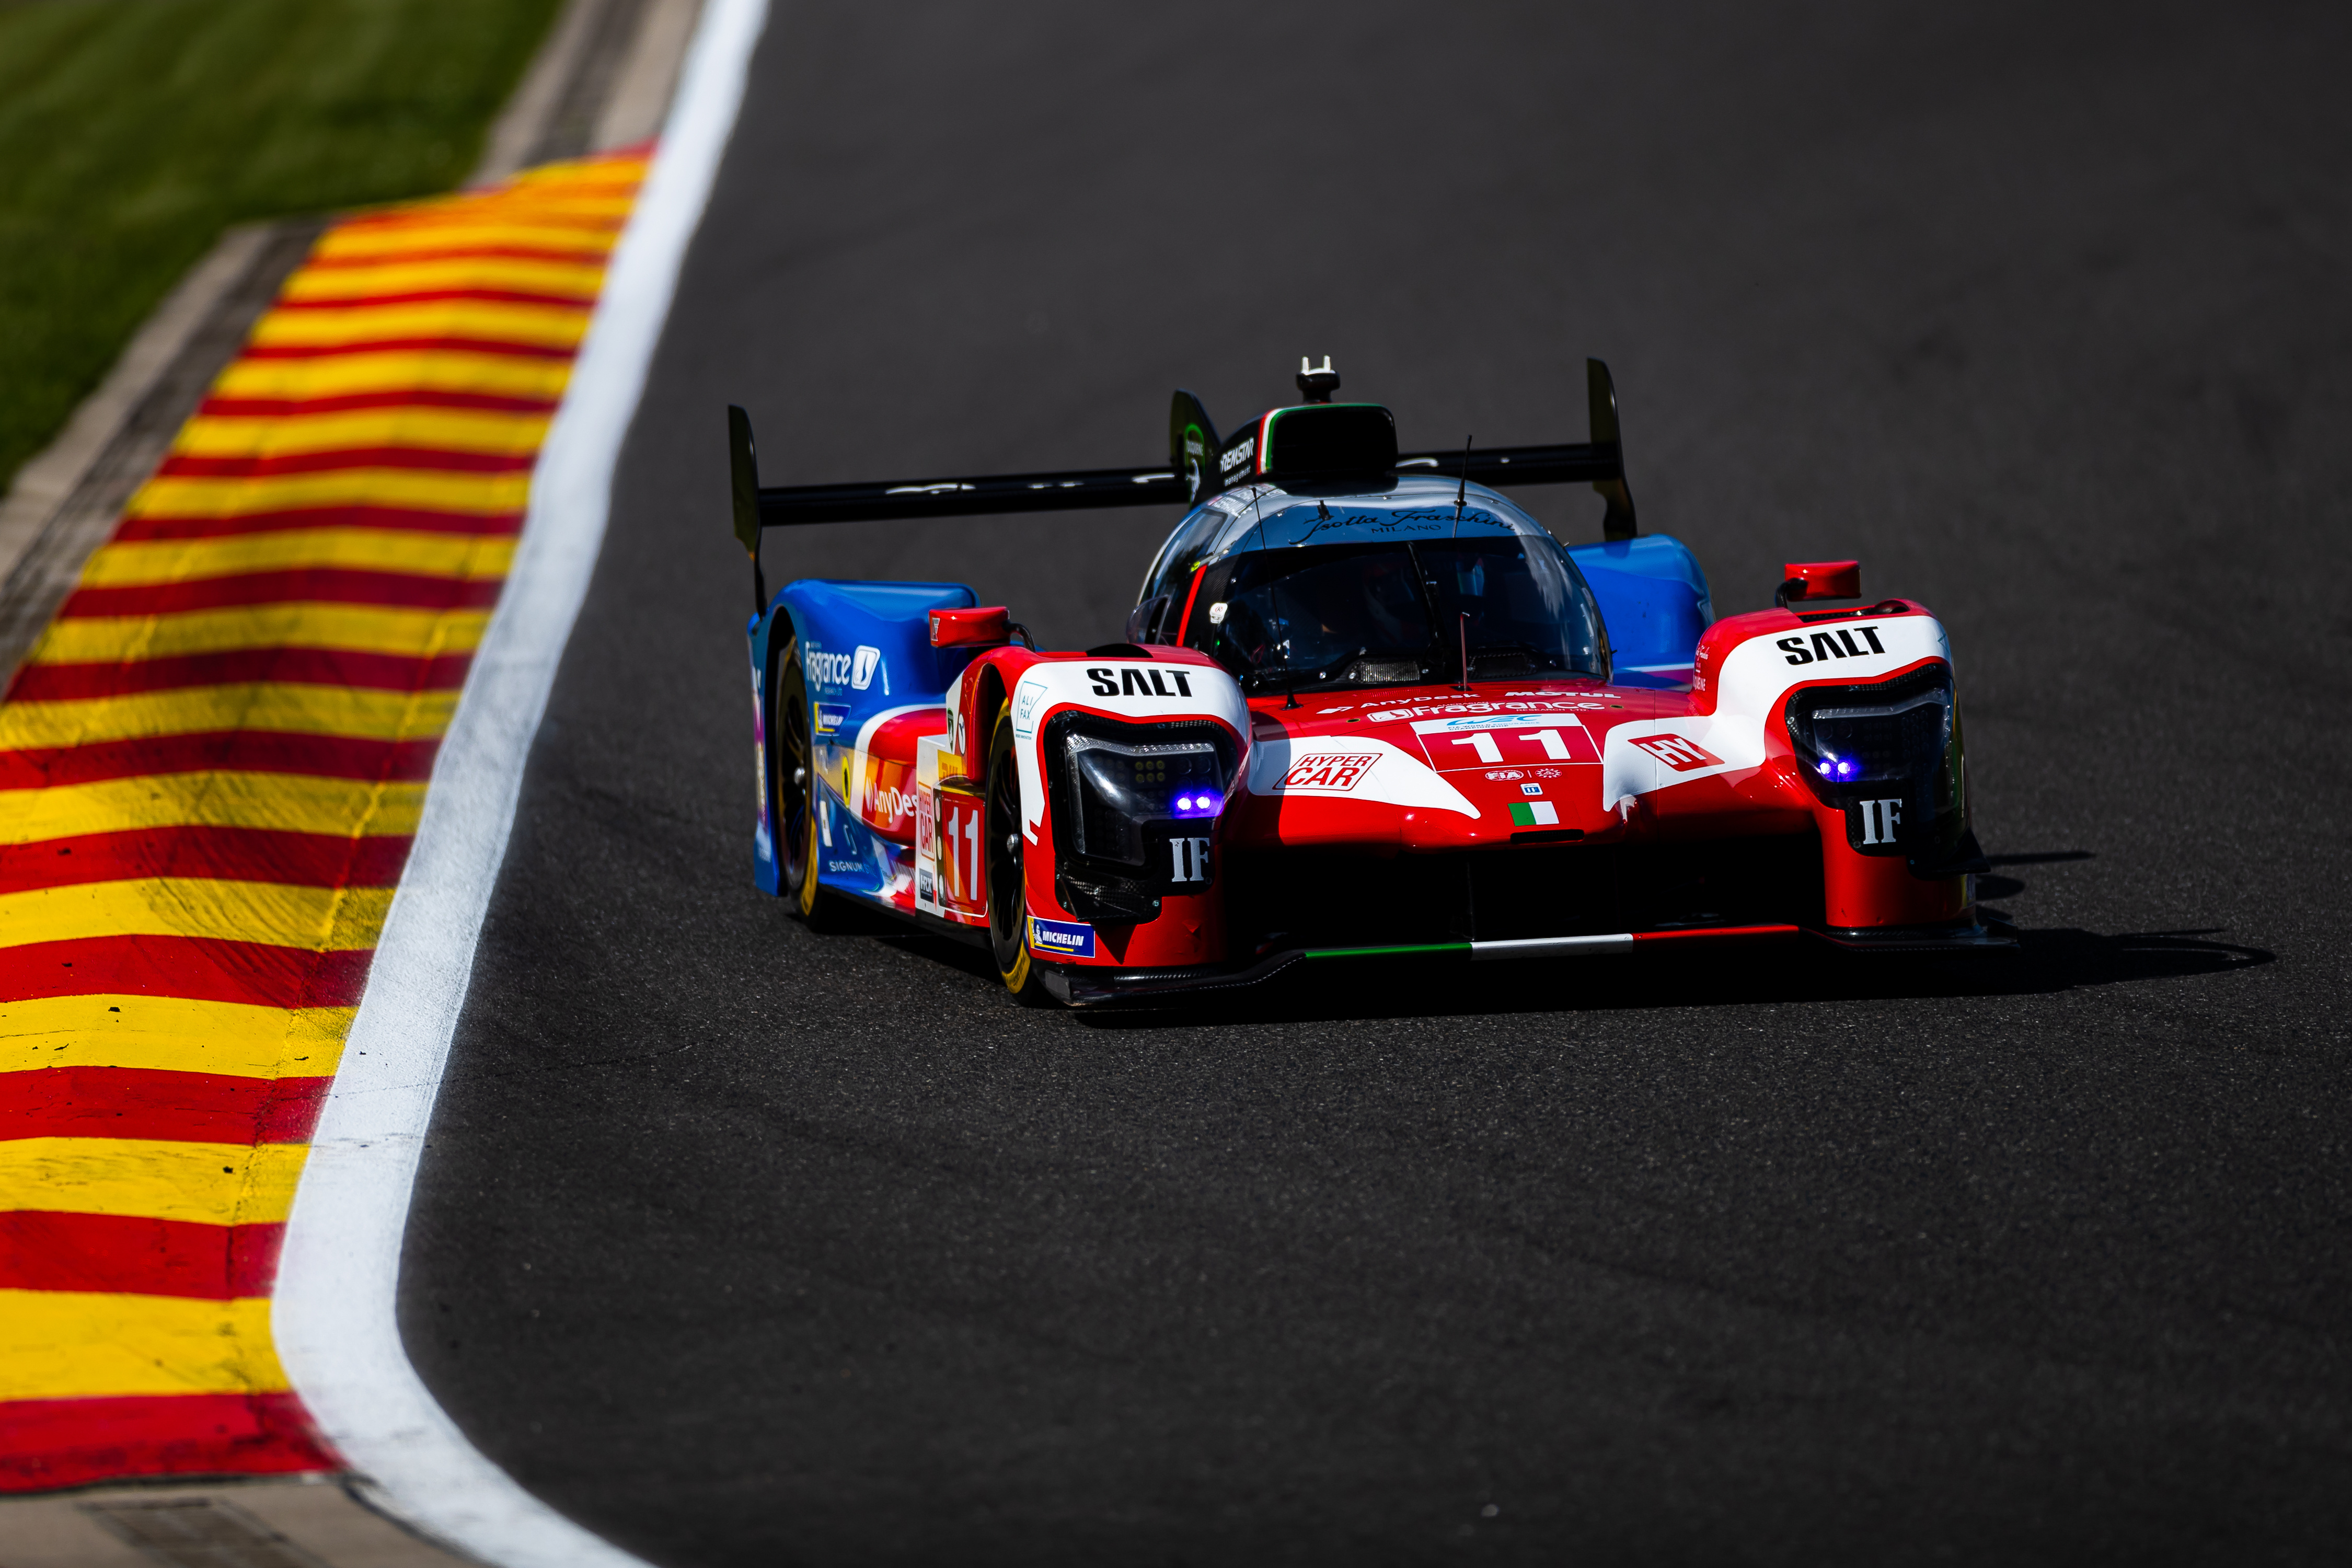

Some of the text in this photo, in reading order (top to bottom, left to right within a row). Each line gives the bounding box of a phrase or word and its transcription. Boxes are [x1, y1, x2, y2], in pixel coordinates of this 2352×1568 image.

[1371, 524, 1442, 535] MILANO
[1379, 510, 1516, 532] Fraschini
[1776, 626, 1886, 665] SALT
[805, 641, 851, 691] Fragrance
[1087, 668, 1192, 697] SALT
[1022, 695, 1033, 706] ALI
[1361, 693, 1481, 708] AnyDesk
[1413, 701, 1605, 716] Fragrance
[1020, 709, 1030, 720] FAX
[1447, 714, 1542, 726] WEC
[1451, 729, 1572, 764] 11
[1639, 738, 1707, 763] HY
[1299, 755, 1371, 768] HYPER
[1284, 766, 1356, 787] CAR
[874, 782, 917, 824] AnyDes
[1859, 799, 1902, 845] IF
[921, 813, 934, 854] CAR
[949, 806, 978, 901] 11
[1169, 838, 1210, 882] IF
[920, 874, 933, 894] HRX
[1042, 931, 1085, 947] MICHELIN
